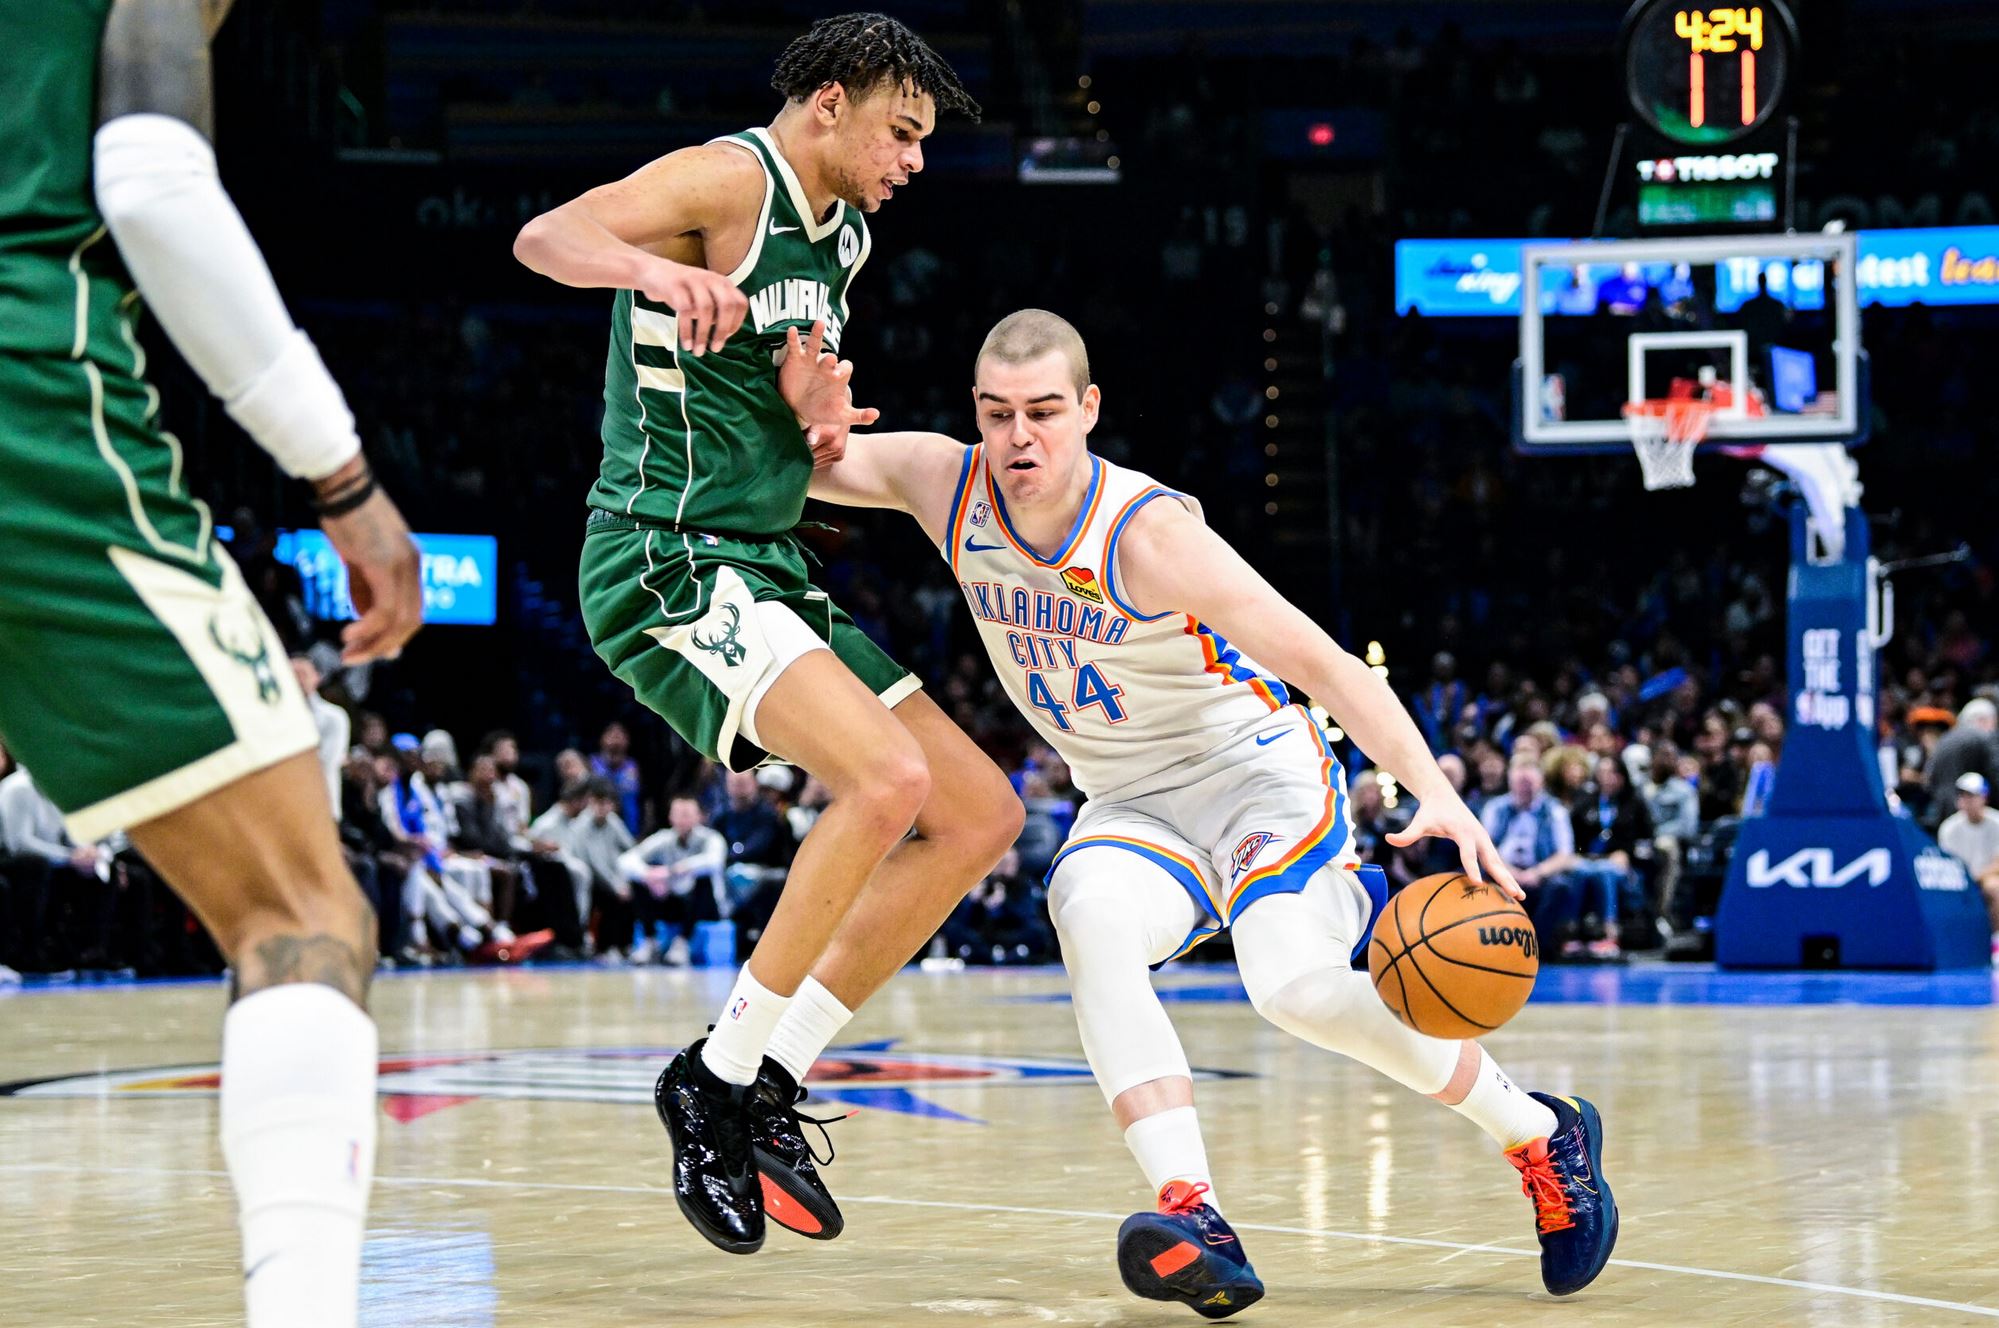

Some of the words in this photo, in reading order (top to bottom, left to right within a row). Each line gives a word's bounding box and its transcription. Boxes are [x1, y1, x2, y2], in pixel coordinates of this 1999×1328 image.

[1675, 7, 1763, 53] 4:24
[1689, 49, 1756, 128] 11
[1674, 152, 1779, 182] TISSOT
[961, 581, 1133, 645] OKLAHOMA
[1006, 630, 1080, 669] CITY
[1026, 660, 1129, 733] 44
[1478, 926, 1539, 960] ilson
